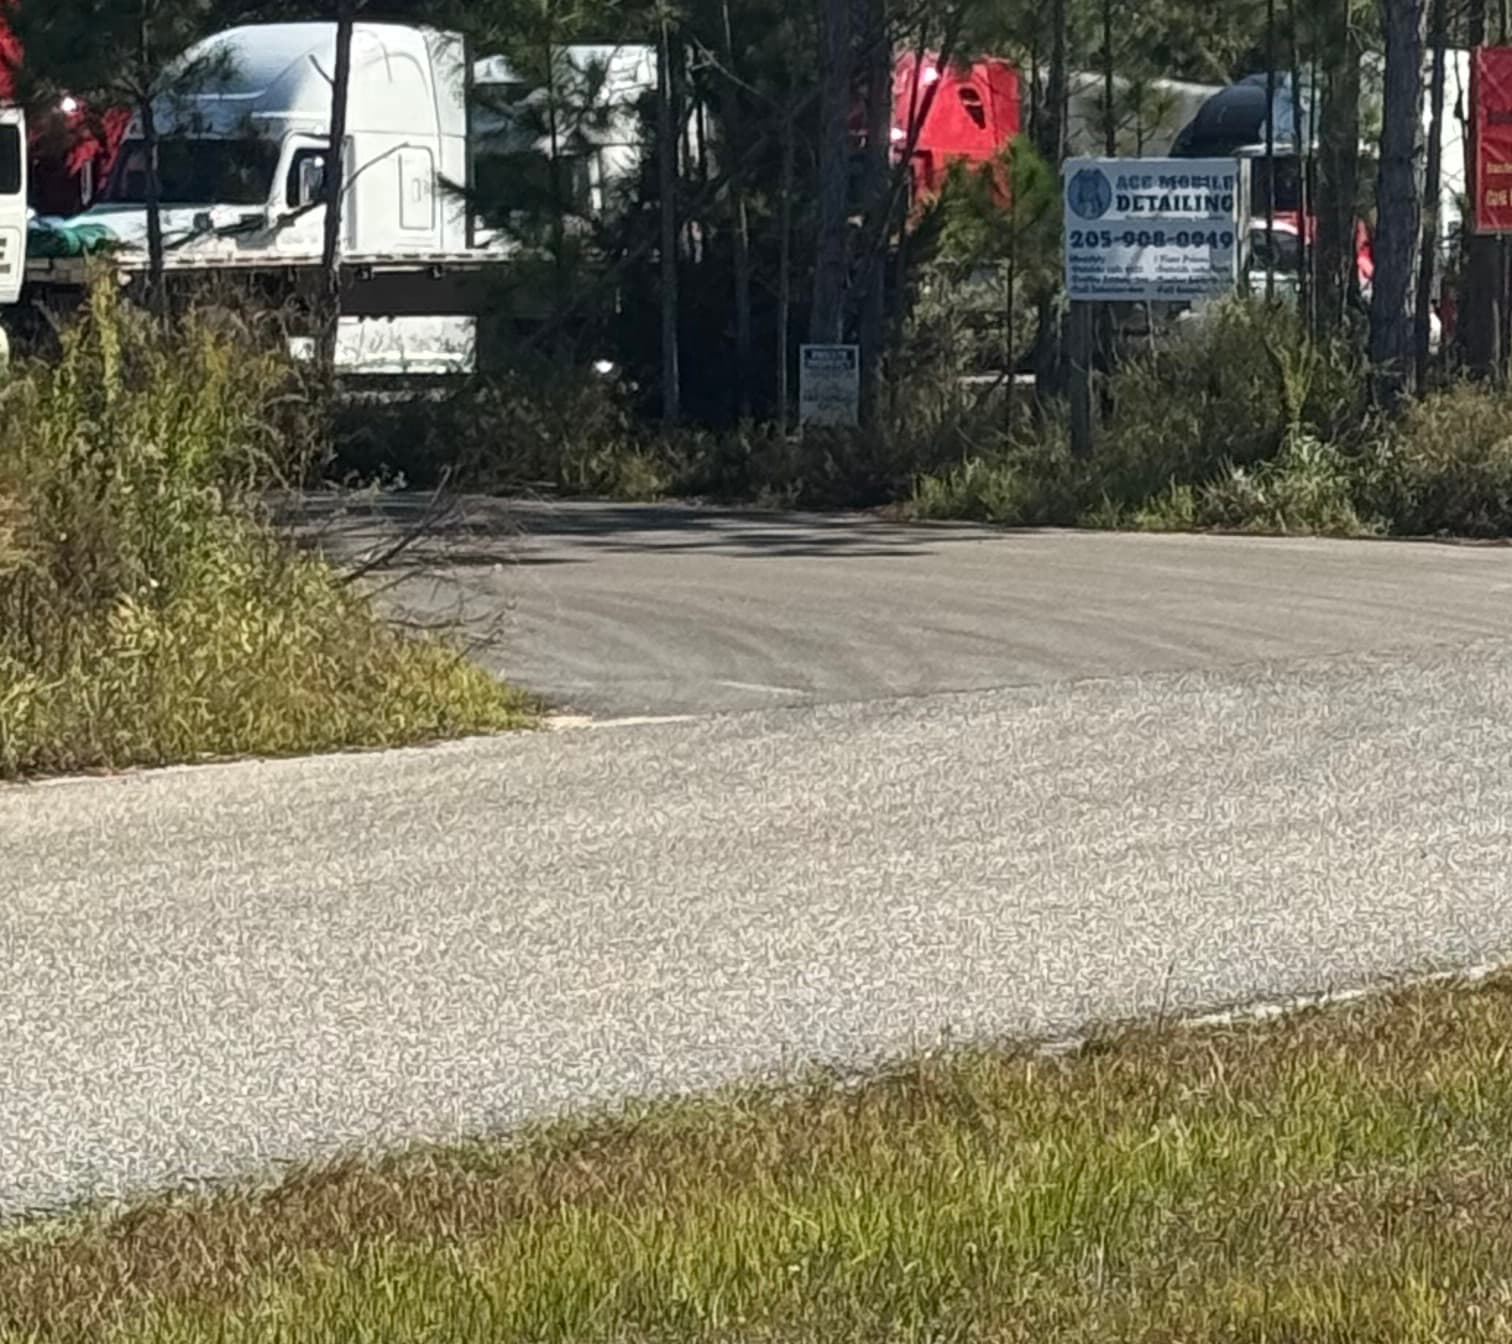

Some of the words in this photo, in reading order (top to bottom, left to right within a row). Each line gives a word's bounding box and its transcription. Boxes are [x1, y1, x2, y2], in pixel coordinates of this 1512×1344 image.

[1116, 175, 1153, 190] ACE
[1159, 175, 1233, 191] MOBILE
[1116, 194, 1233, 212] DETAILING
